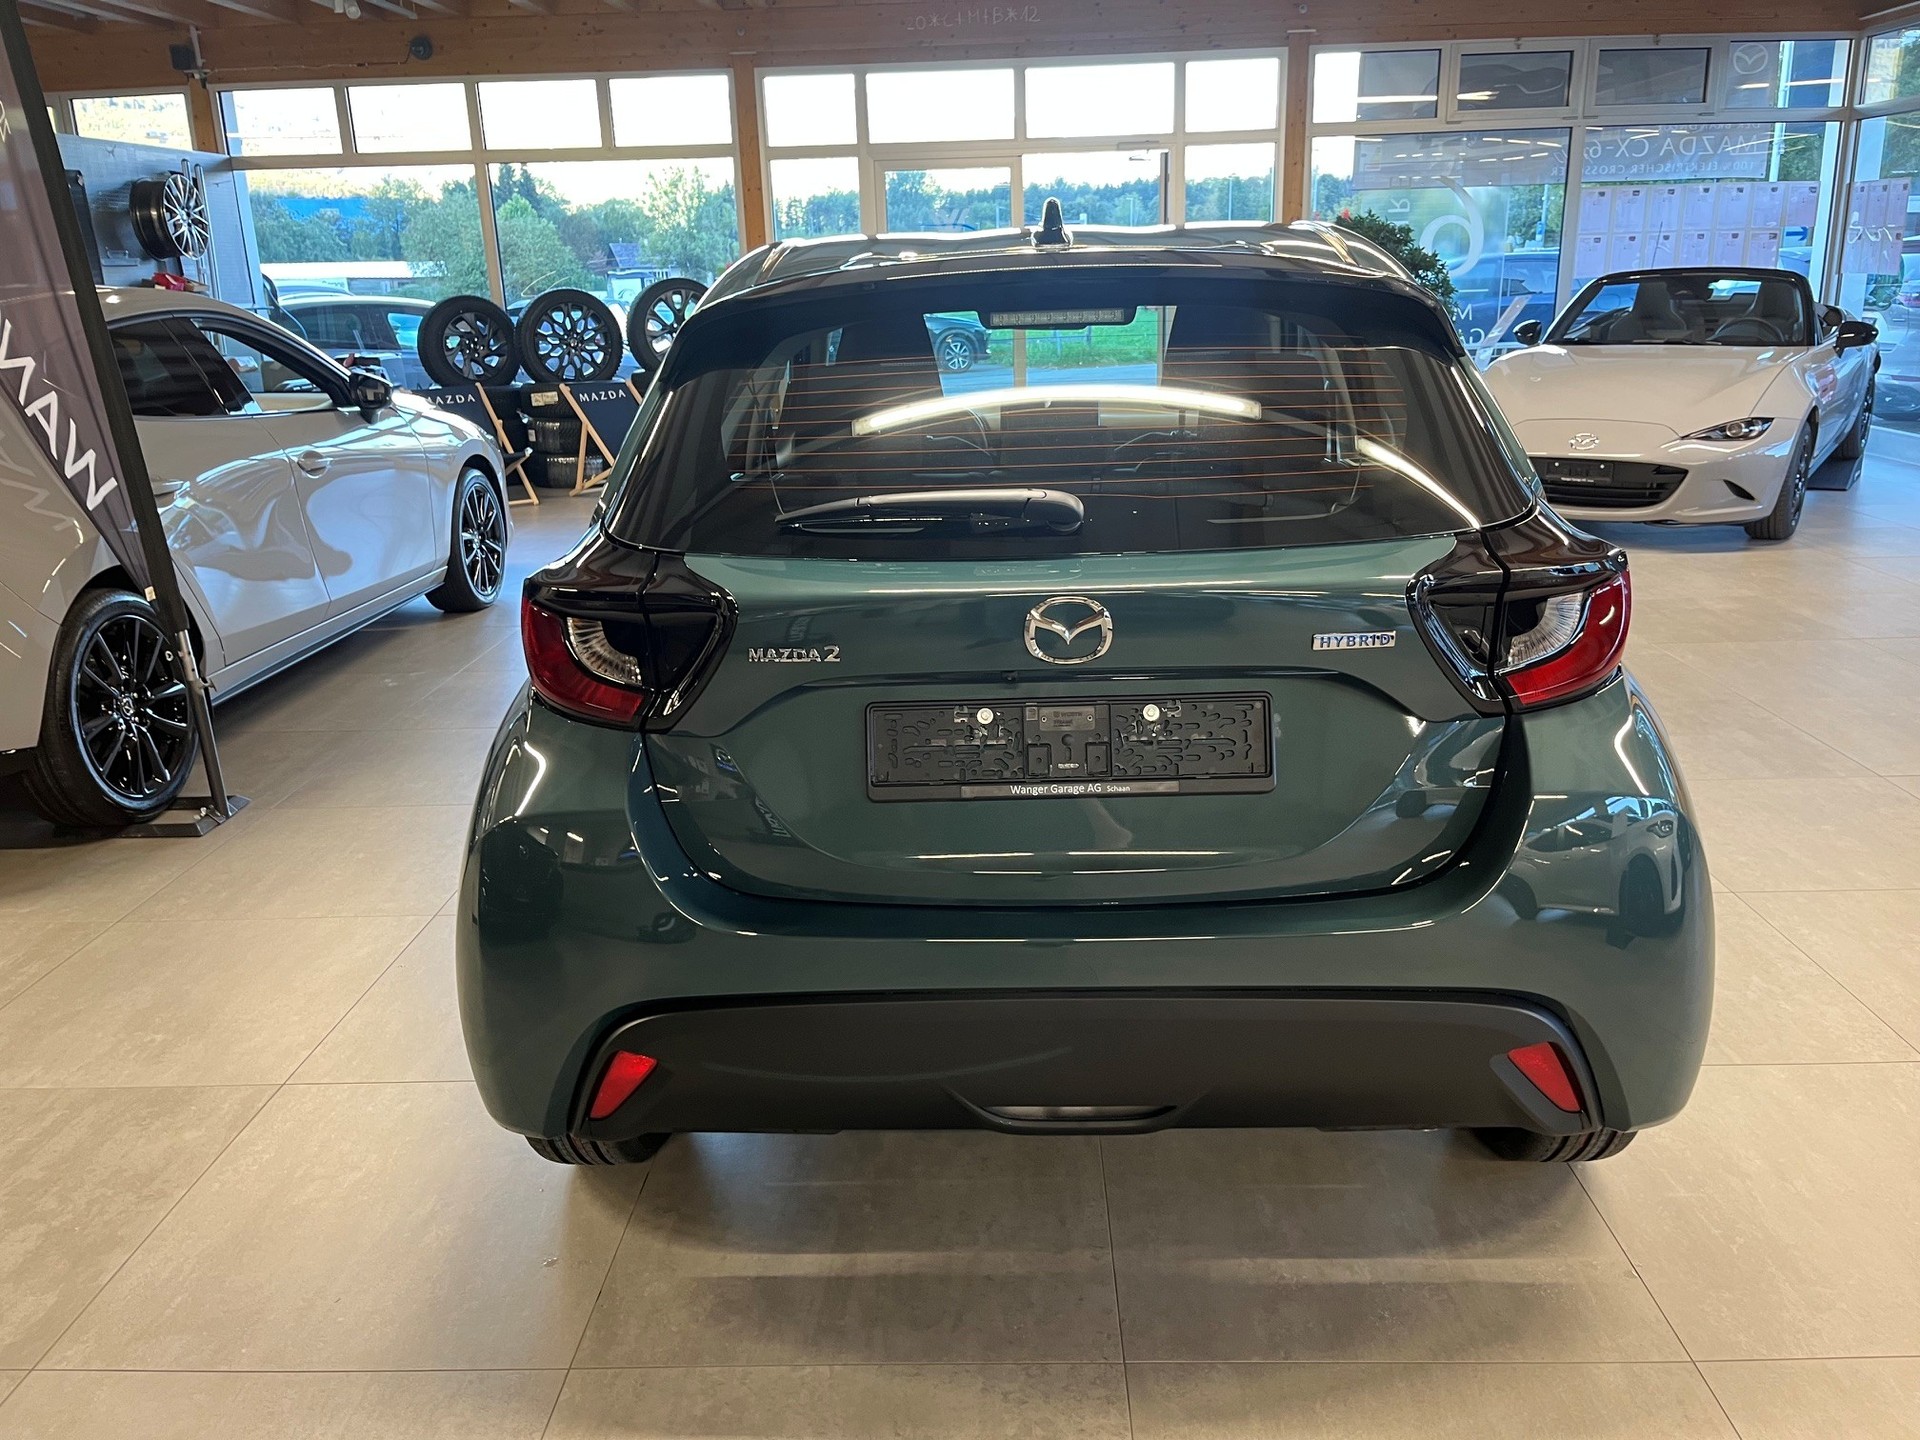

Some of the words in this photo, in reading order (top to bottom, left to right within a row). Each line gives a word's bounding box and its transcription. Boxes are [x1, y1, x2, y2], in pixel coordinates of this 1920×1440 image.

[579, 389, 626, 403] MAZDA
[1319, 633, 1391, 648] HYBRID
[1010, 785, 1048, 796] Wanger
[1050, 783, 1085, 796] Garage
[1087, 783, 1102, 793] AG
